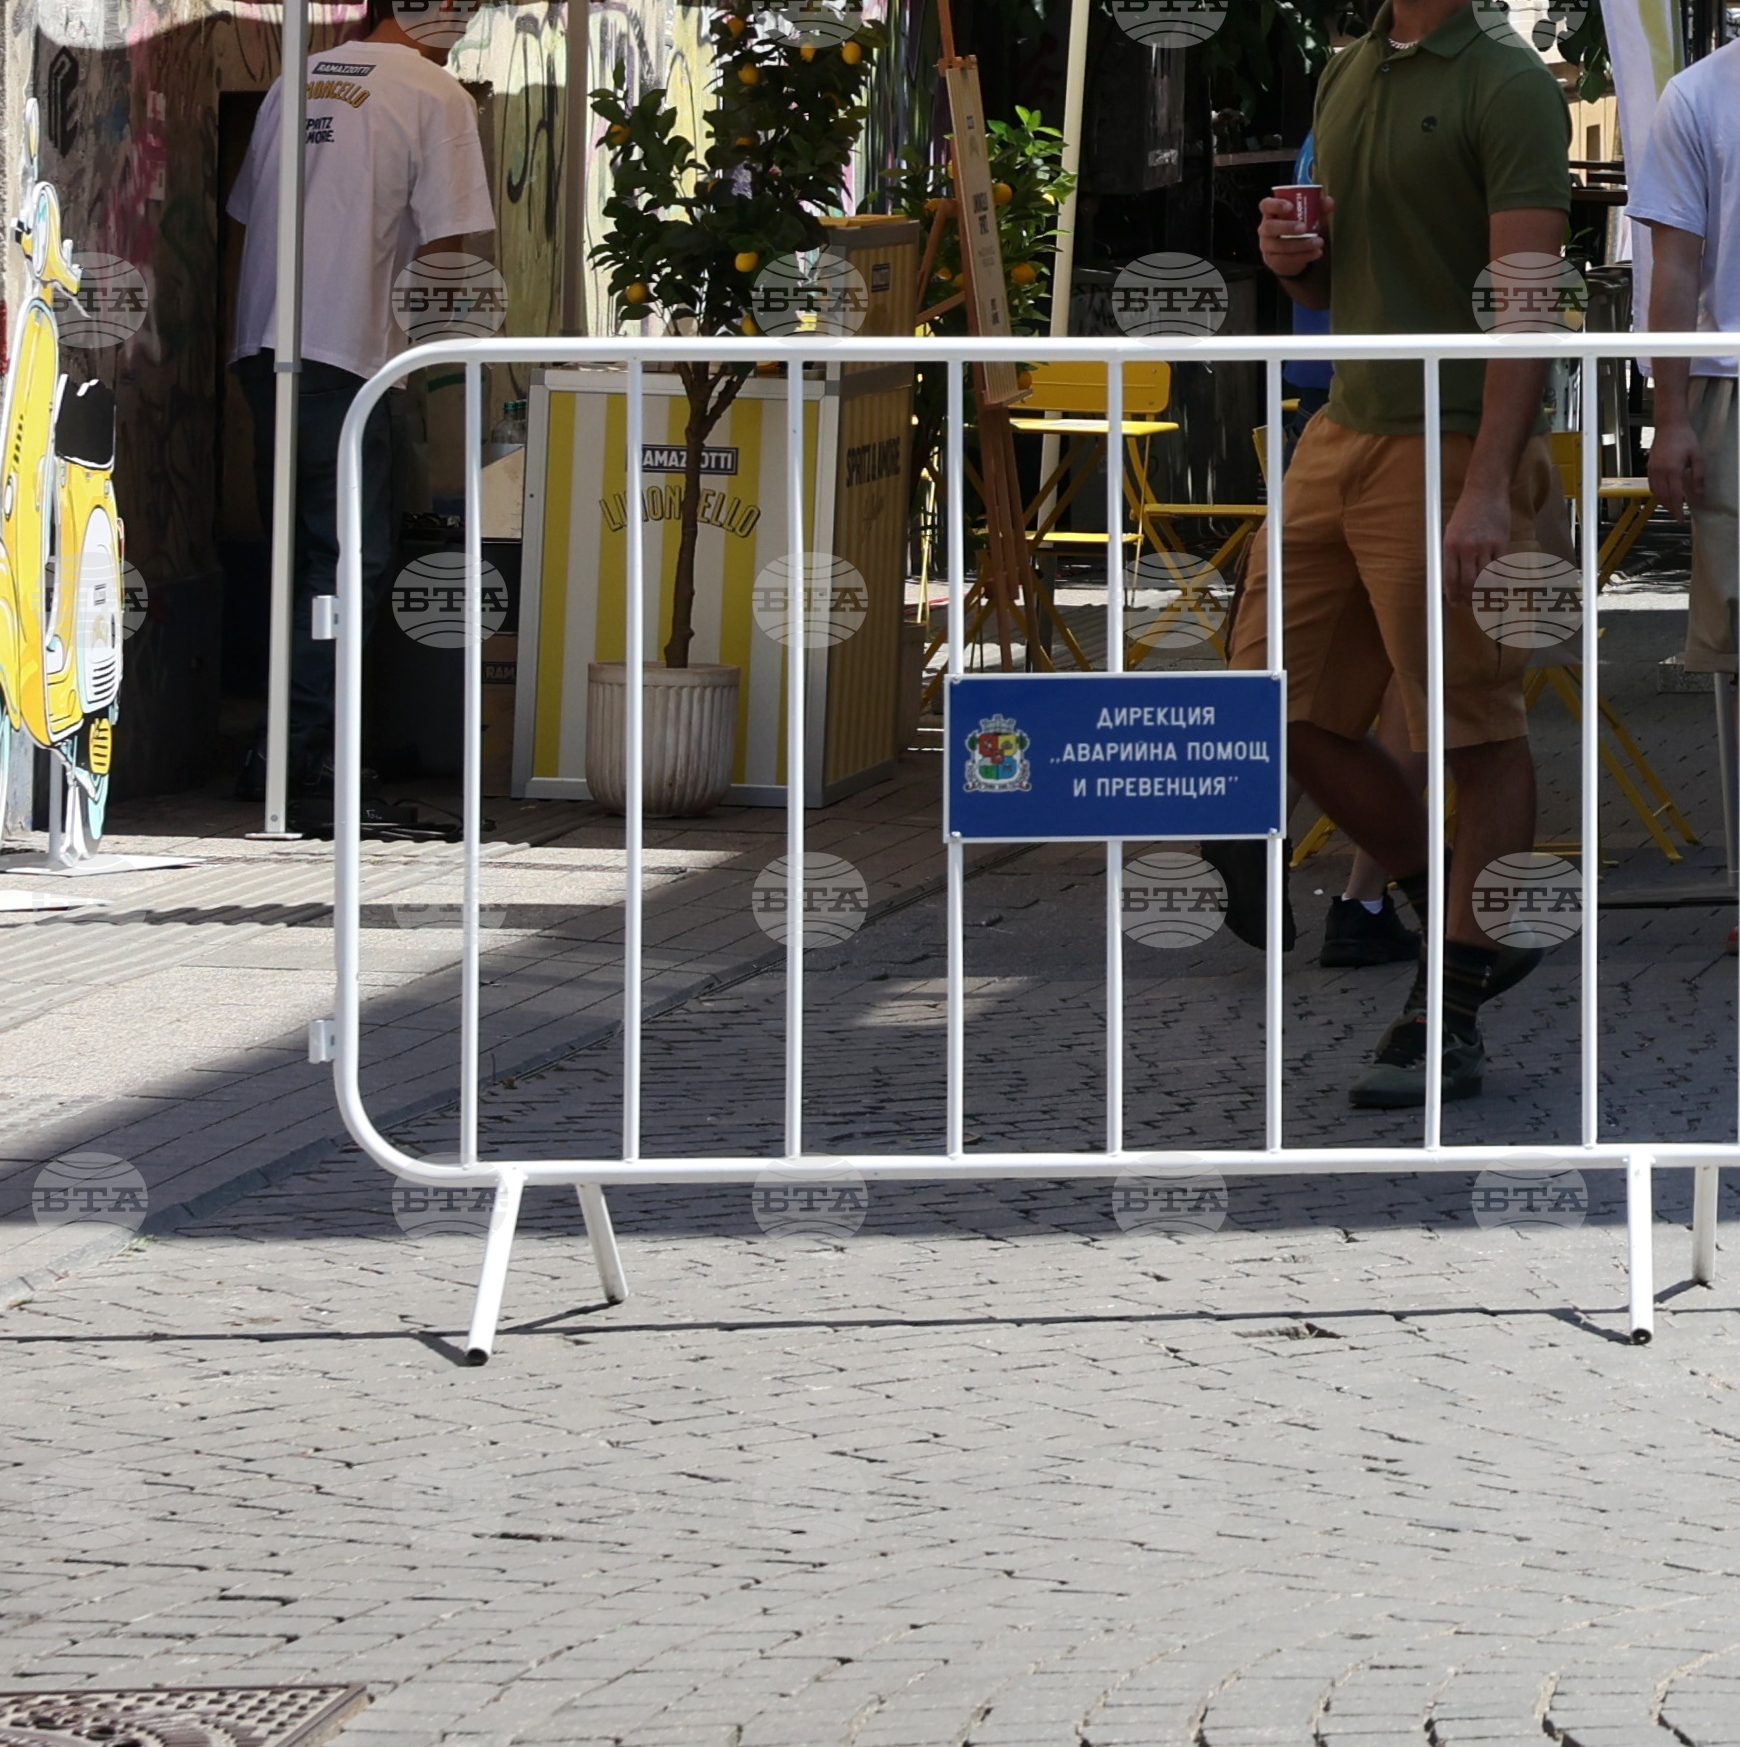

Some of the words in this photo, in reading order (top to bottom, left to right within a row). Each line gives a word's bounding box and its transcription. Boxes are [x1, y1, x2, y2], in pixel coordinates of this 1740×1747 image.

[641, 449, 734, 470] AMAZOTTI
[1097, 707, 1216, 730] ДИРЕКЦИЯ
[1188, 740, 1270, 762] ПОМОЩ
[1073, 778, 1087, 797] И
